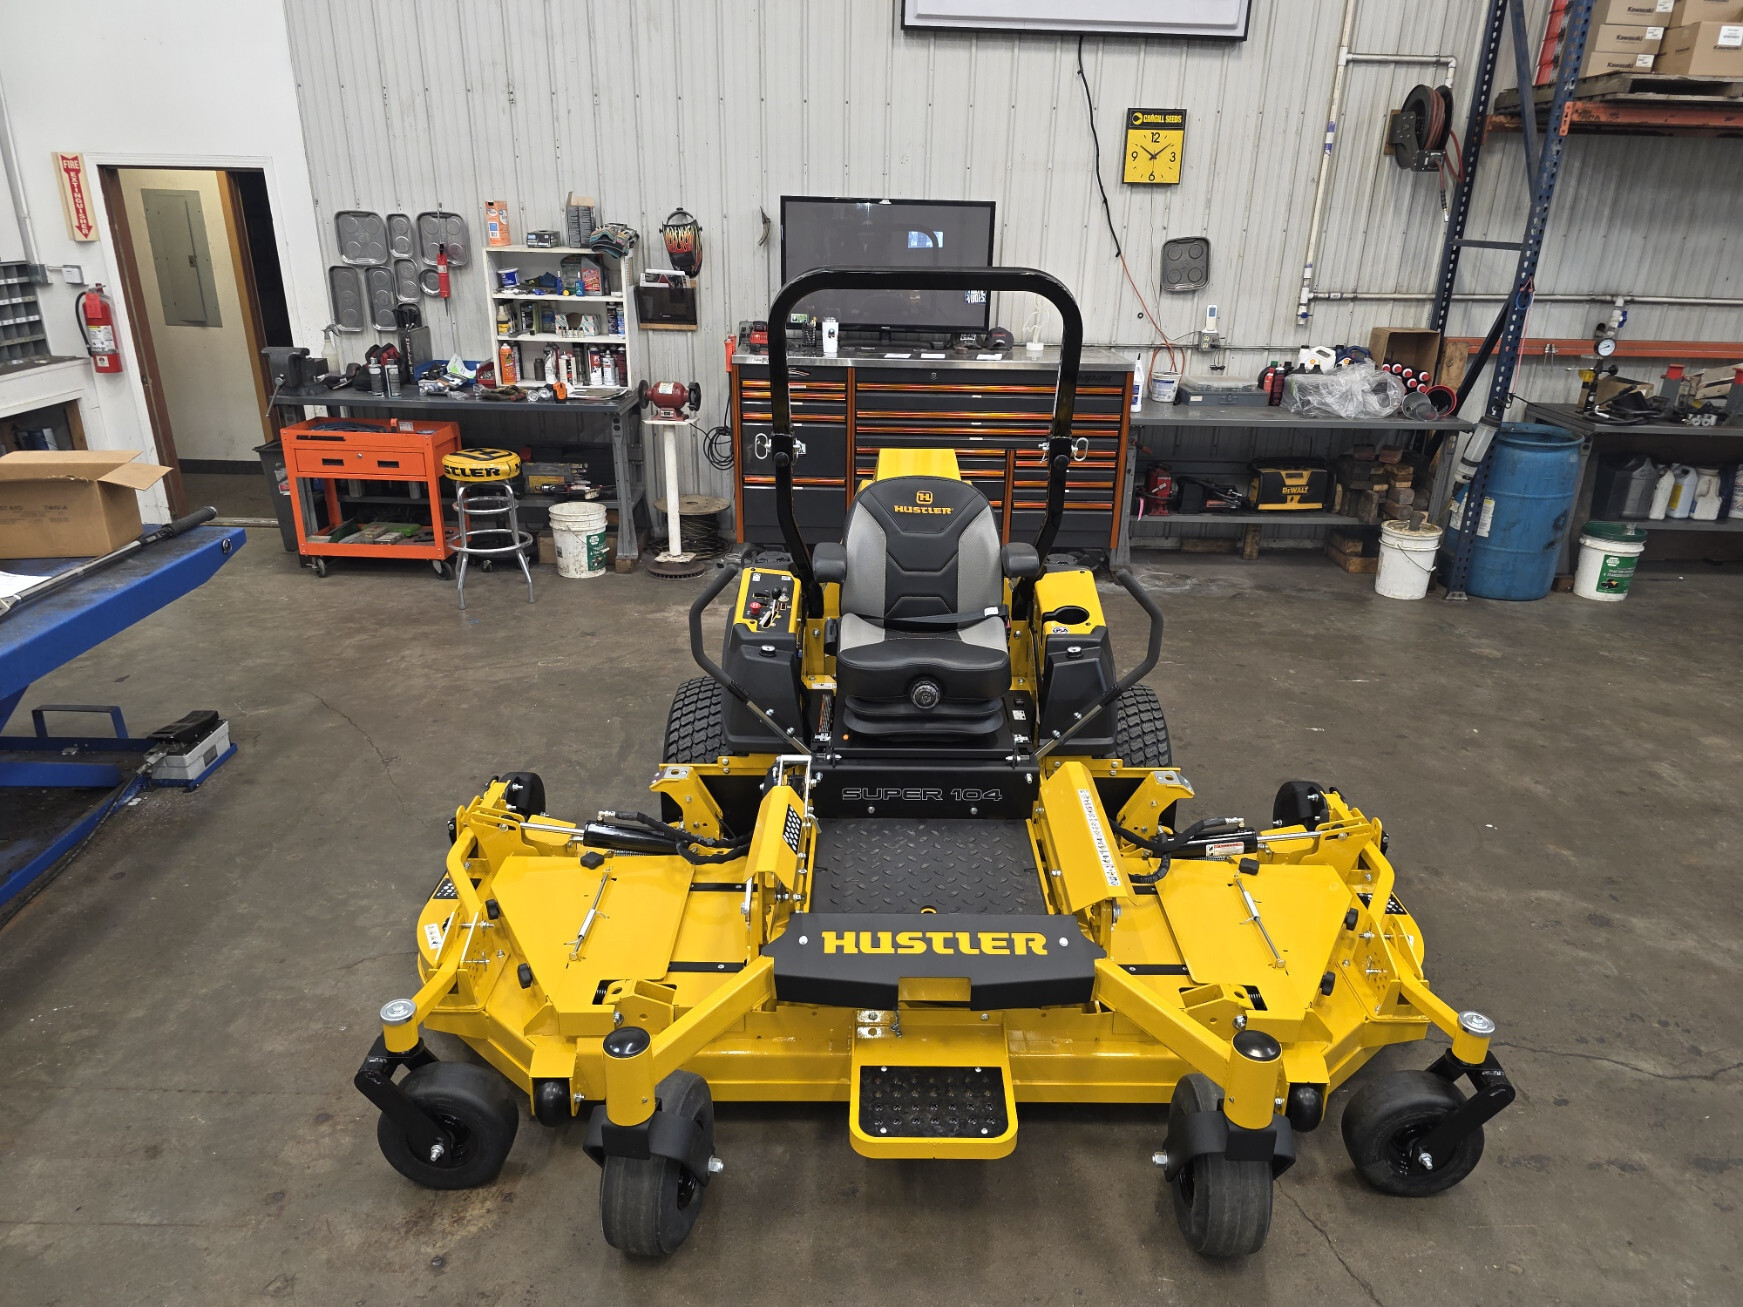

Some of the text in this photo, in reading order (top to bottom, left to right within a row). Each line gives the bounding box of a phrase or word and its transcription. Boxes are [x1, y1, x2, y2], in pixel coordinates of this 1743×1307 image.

[1627, 6, 1655, 14] Kawasaki
[1616, 34, 1643, 42] Kawasaki
[1165, 115, 1182, 123] SEEDS
[1151, 132, 1161, 143] 12
[1131, 151, 1176, 162] 9 3
[63, 160, 80, 169] FIRE
[1148, 171, 1155, 181] 6
[70, 171, 89, 234] EXTINGUISHER
[893, 505, 952, 514] HUSTLER
[842, 787, 1002, 801] SUPER 104
[821, 931, 1048, 955] HUSTLER
